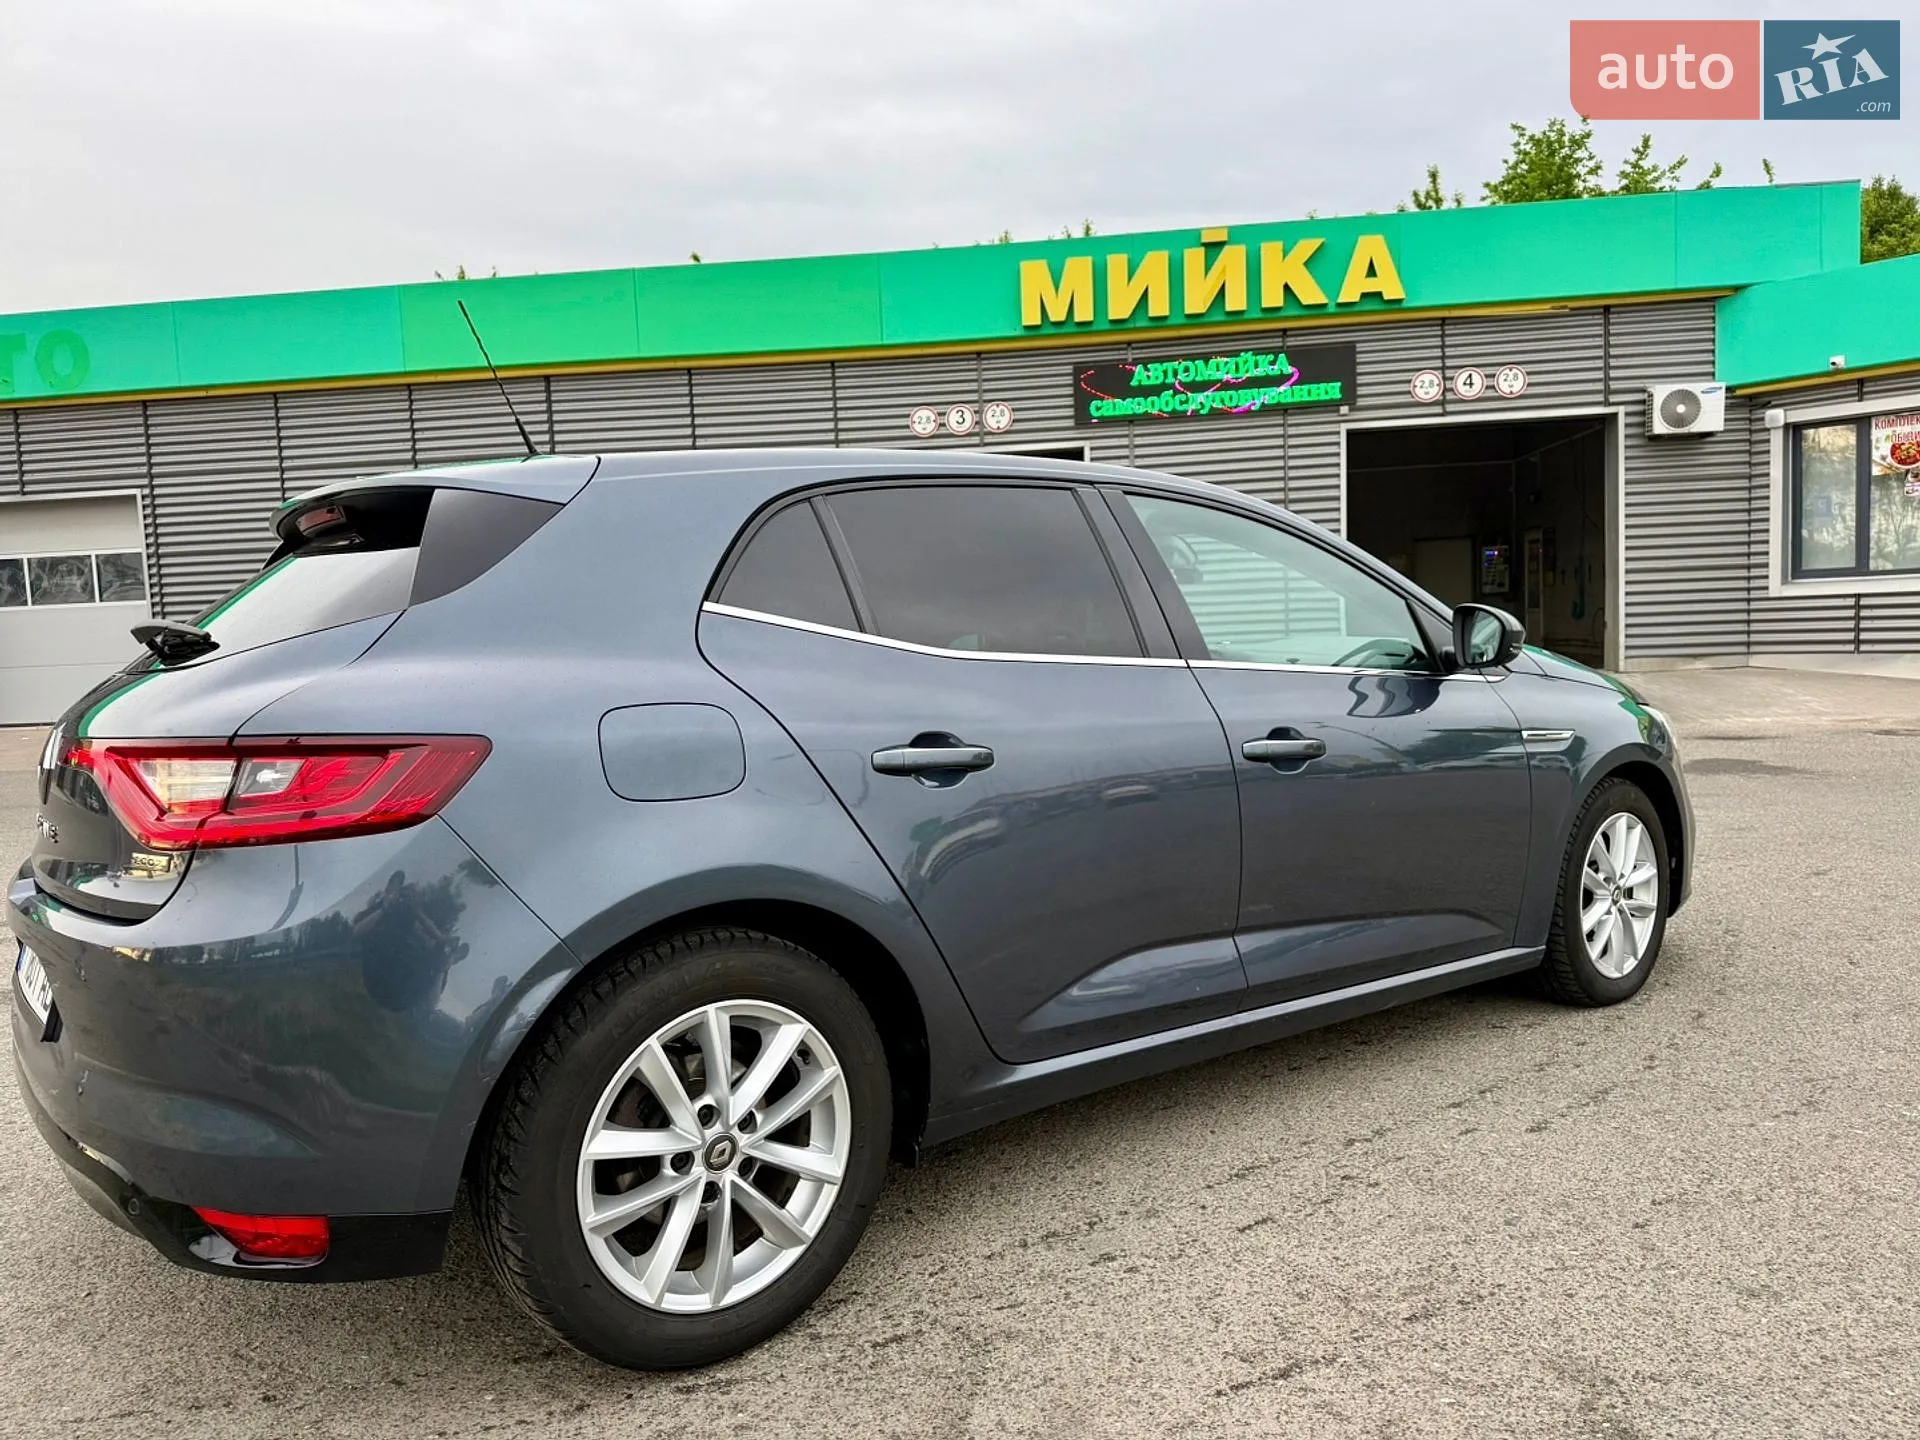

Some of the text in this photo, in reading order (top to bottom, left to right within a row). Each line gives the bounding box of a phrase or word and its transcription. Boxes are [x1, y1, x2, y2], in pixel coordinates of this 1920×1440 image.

[1019, 226, 1406, 327] МИЙКА
[1130, 350, 1292, 386] АВТОМИЙКА
[1463, 373, 1475, 388] 4
[955, 409, 965, 425] 3
